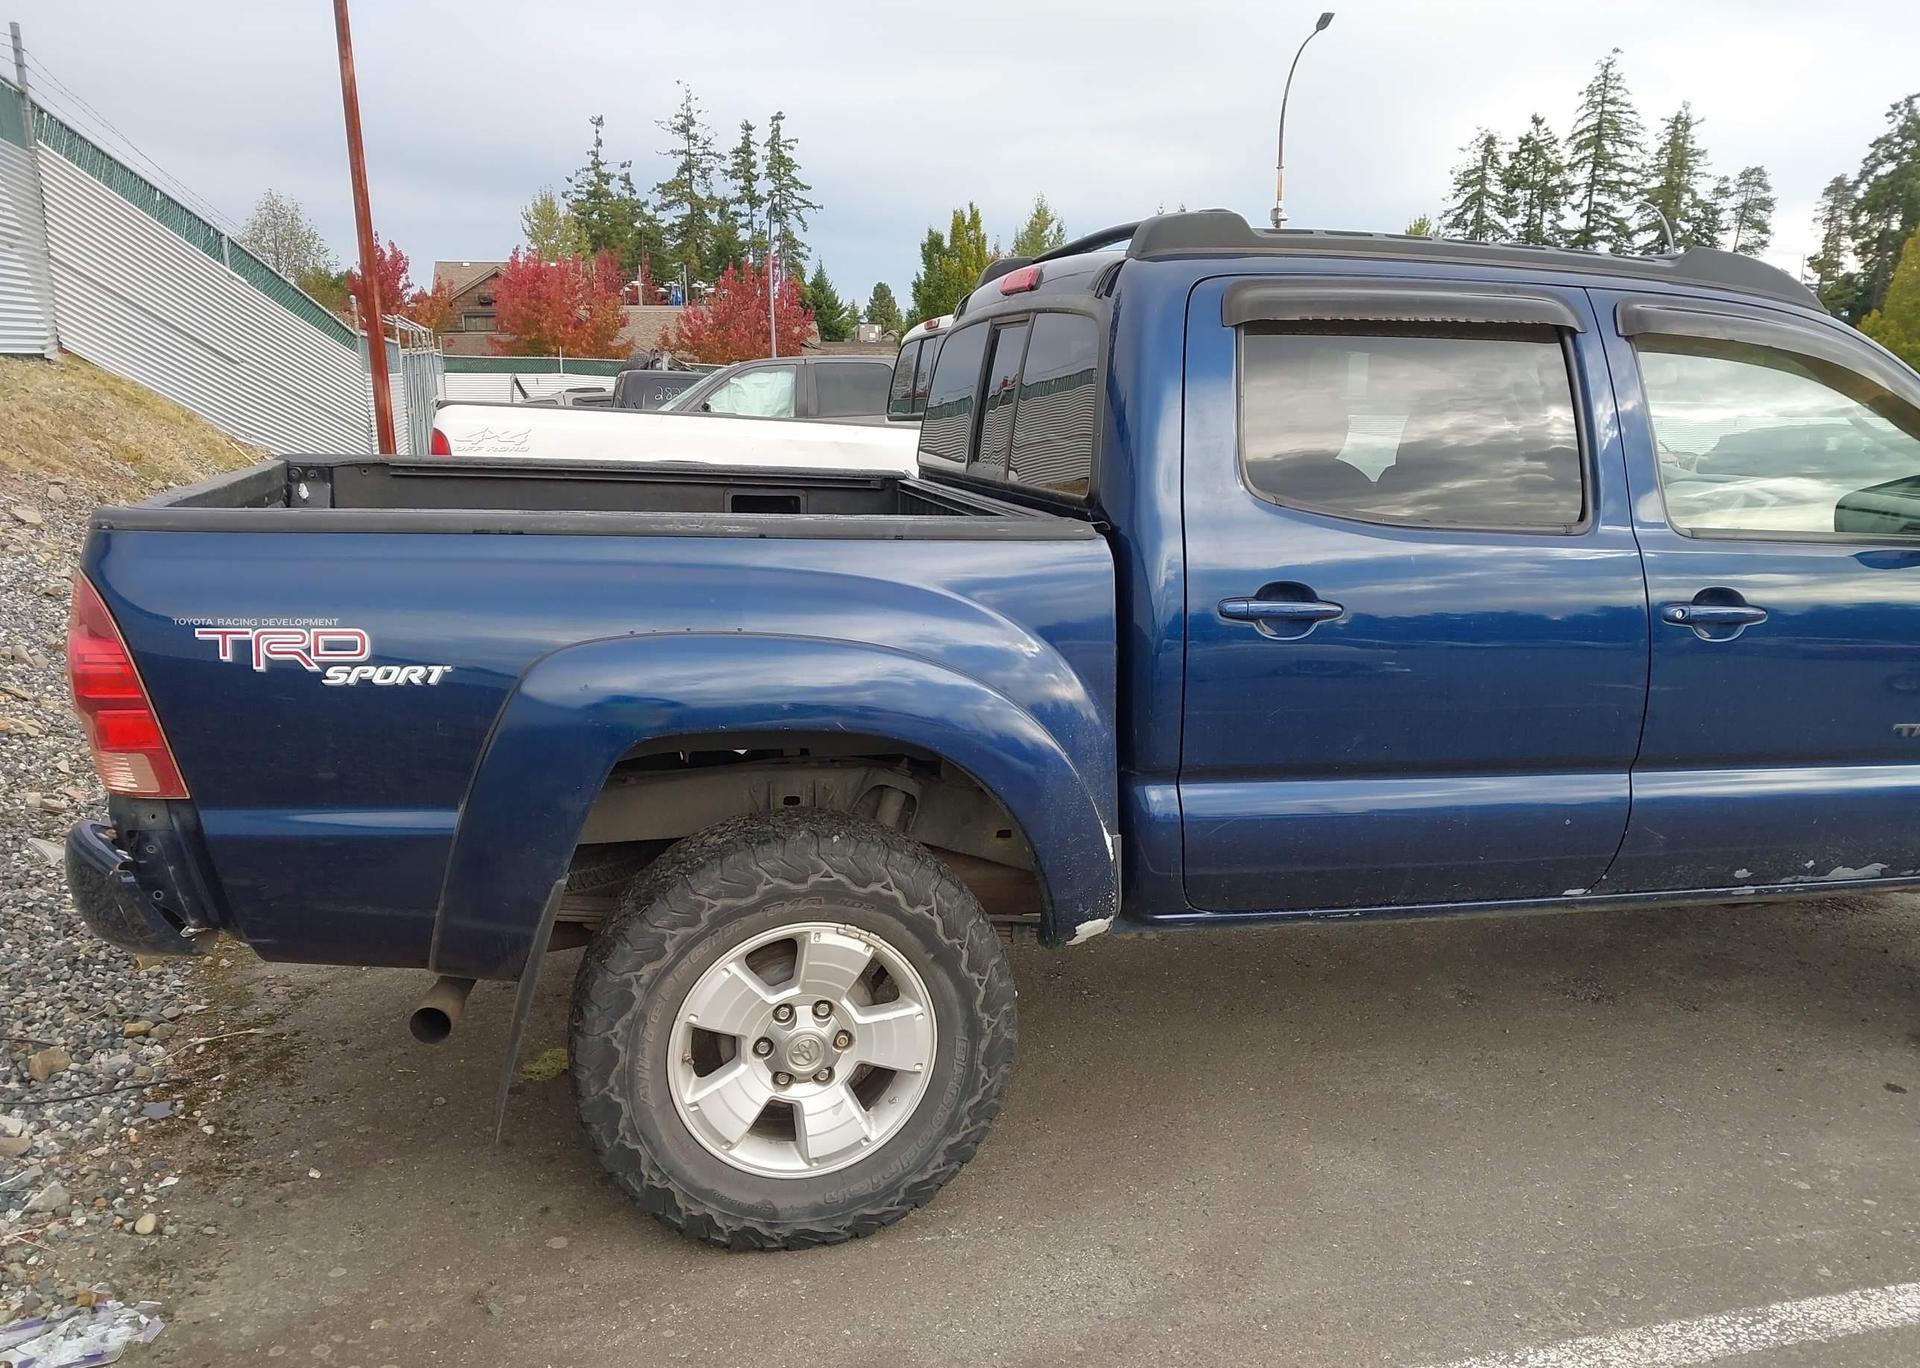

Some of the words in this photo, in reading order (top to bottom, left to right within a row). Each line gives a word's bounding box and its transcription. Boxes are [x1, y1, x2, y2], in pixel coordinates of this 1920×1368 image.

[172, 617, 213, 627] TOYOTA
[217, 617, 258, 627] RACING
[261, 617, 340, 627] DEVELOPMENT
[195, 628, 371, 673] TRD
[321, 665, 453, 686] SPORT
[823, 1036, 969, 1205] BFGoodrich
